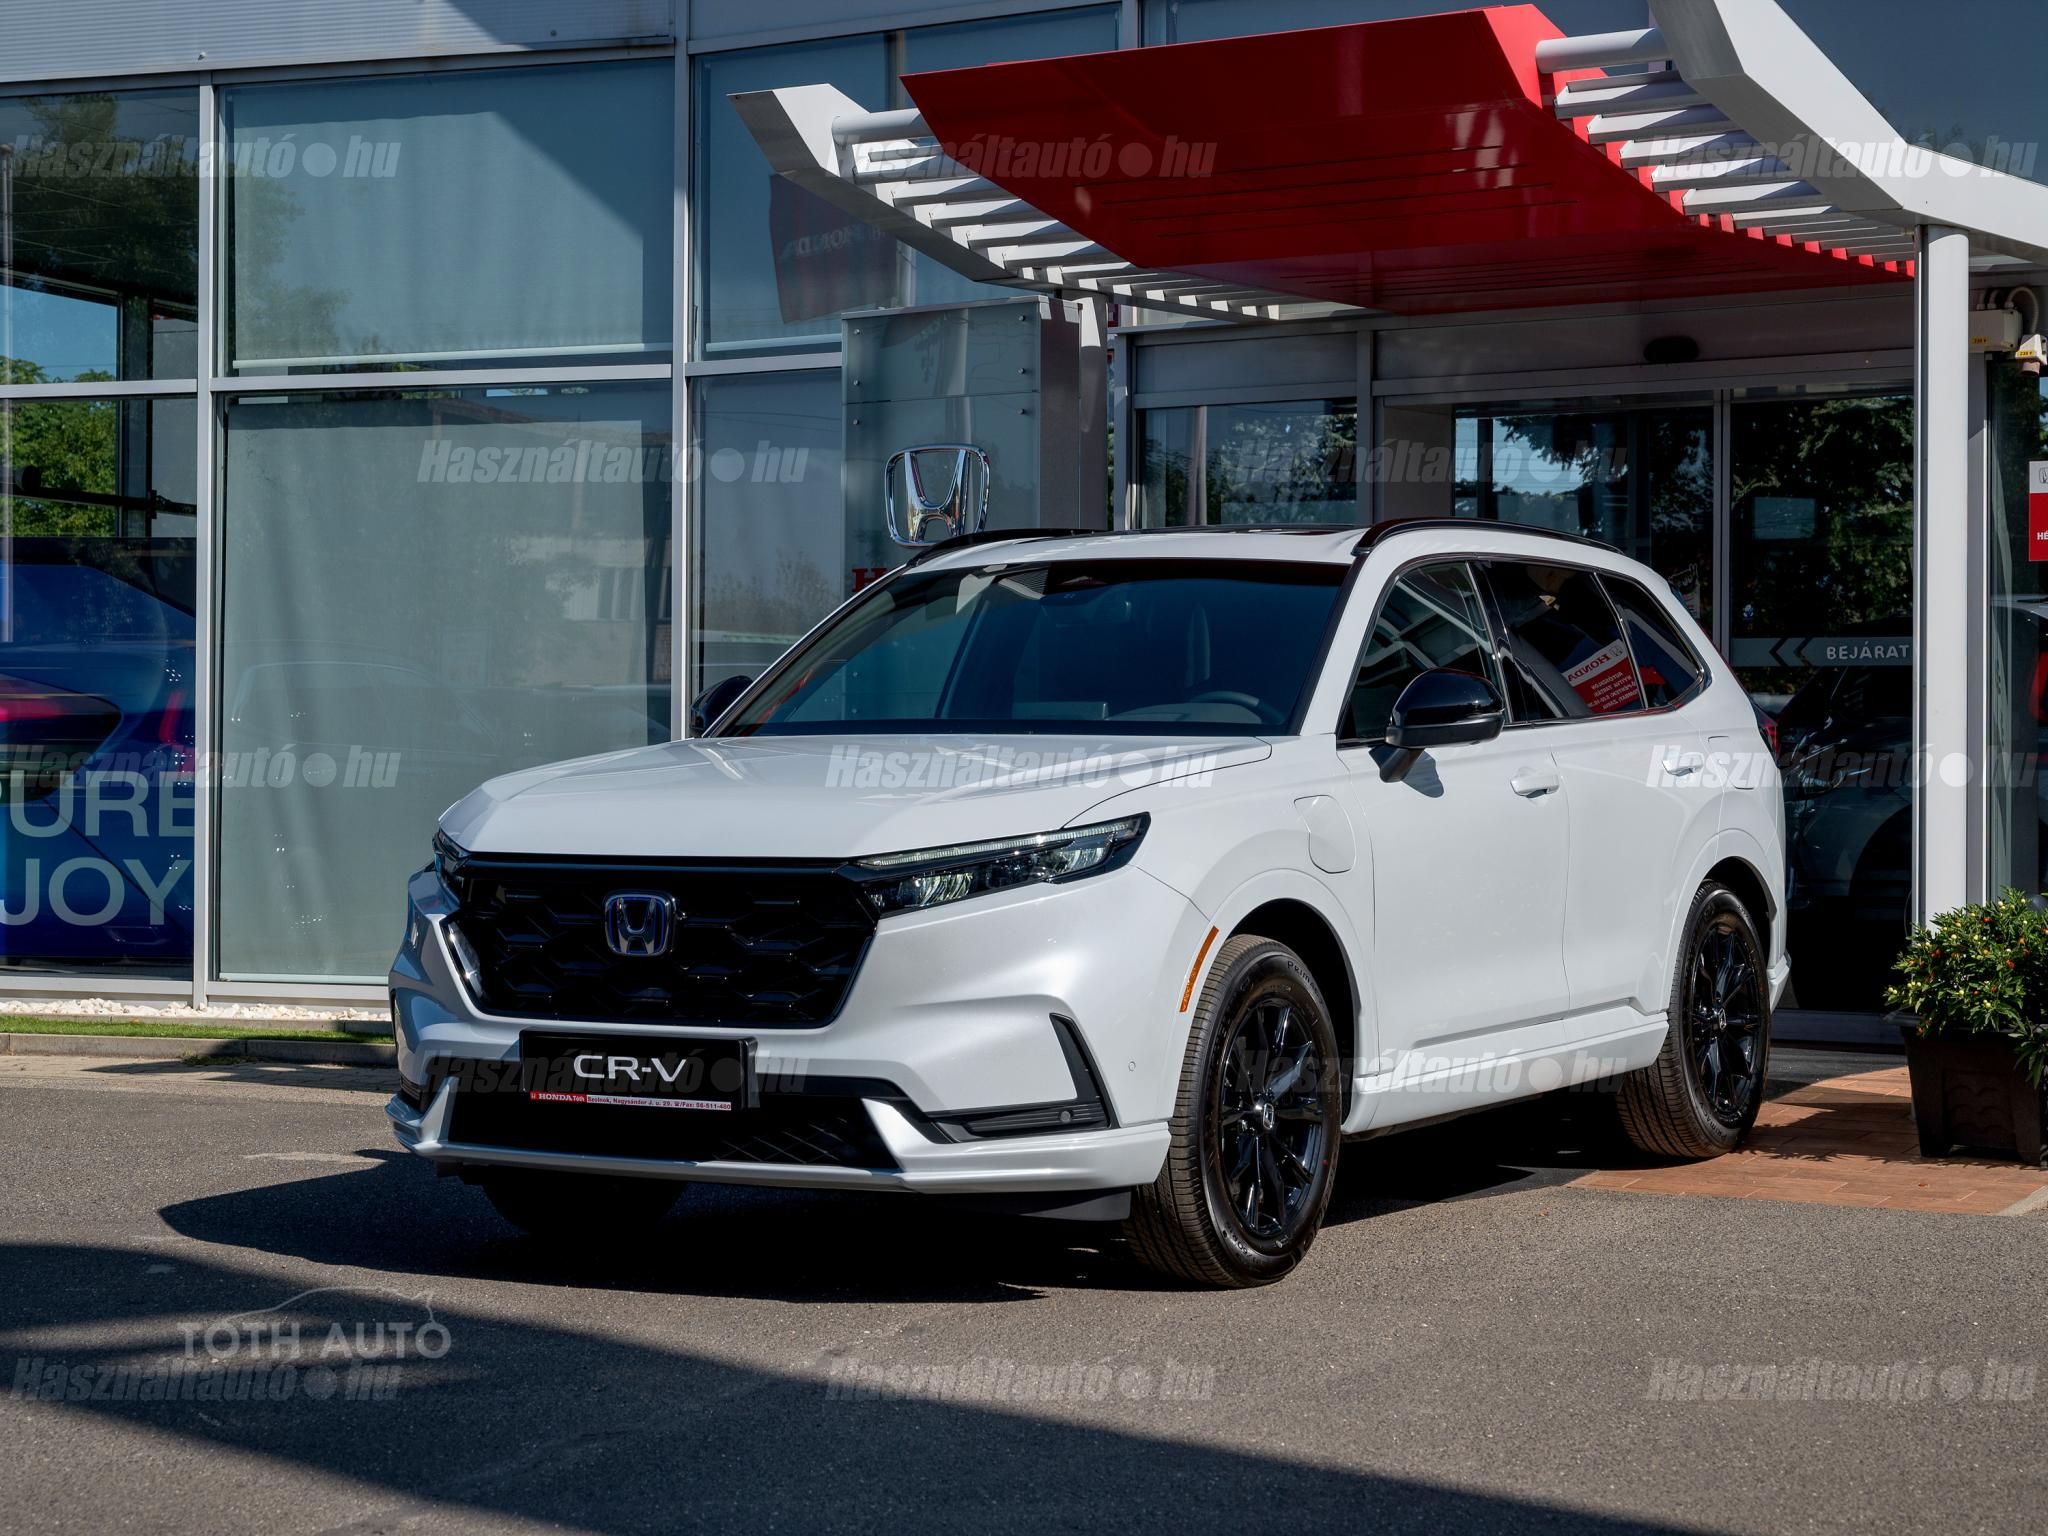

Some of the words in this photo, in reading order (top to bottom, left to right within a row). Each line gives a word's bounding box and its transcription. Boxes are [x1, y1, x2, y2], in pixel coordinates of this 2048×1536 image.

[1826, 641, 1909, 660] BEJÁRAT
[0, 769, 194, 838] URE
[0, 856, 192, 927] JOY
[573, 1054, 687, 1082] CR-V
[538, 1092, 573, 1102] HONDA
